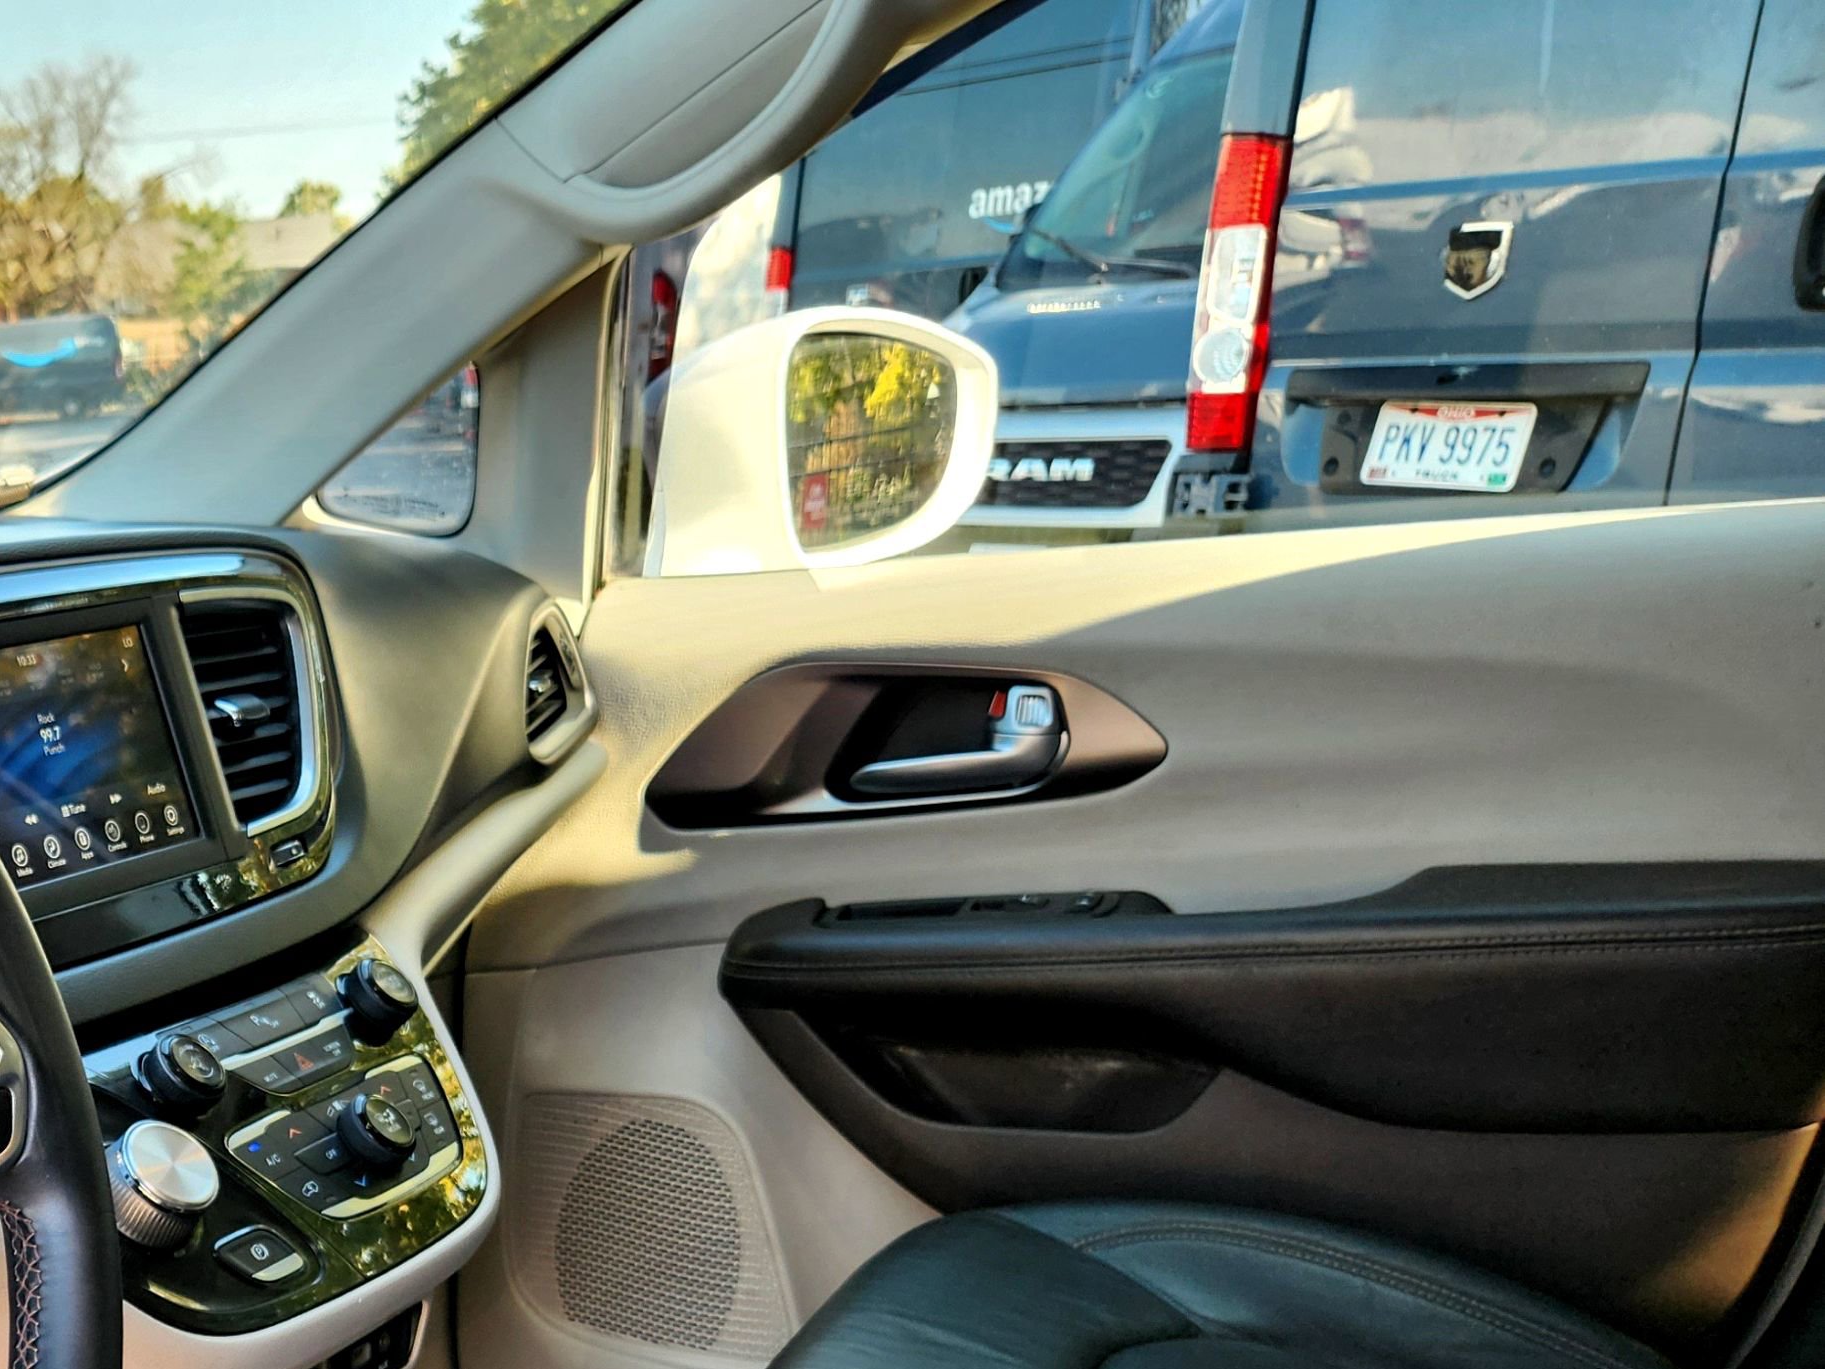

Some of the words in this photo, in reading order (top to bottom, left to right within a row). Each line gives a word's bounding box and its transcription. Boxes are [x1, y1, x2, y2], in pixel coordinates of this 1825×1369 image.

[969, 179, 1052, 219] amaz
[1378, 422, 1435, 463] PKV
[1439, 426, 1516, 467] 9975
[986, 458, 1095, 481] RAM
[16, 653, 37, 667] 10:33
[37, 712, 56, 725] Rock
[40, 726, 61, 743] 99.7
[43, 742, 66, 756] Punch
[265, 1153, 281, 1167] A/C
